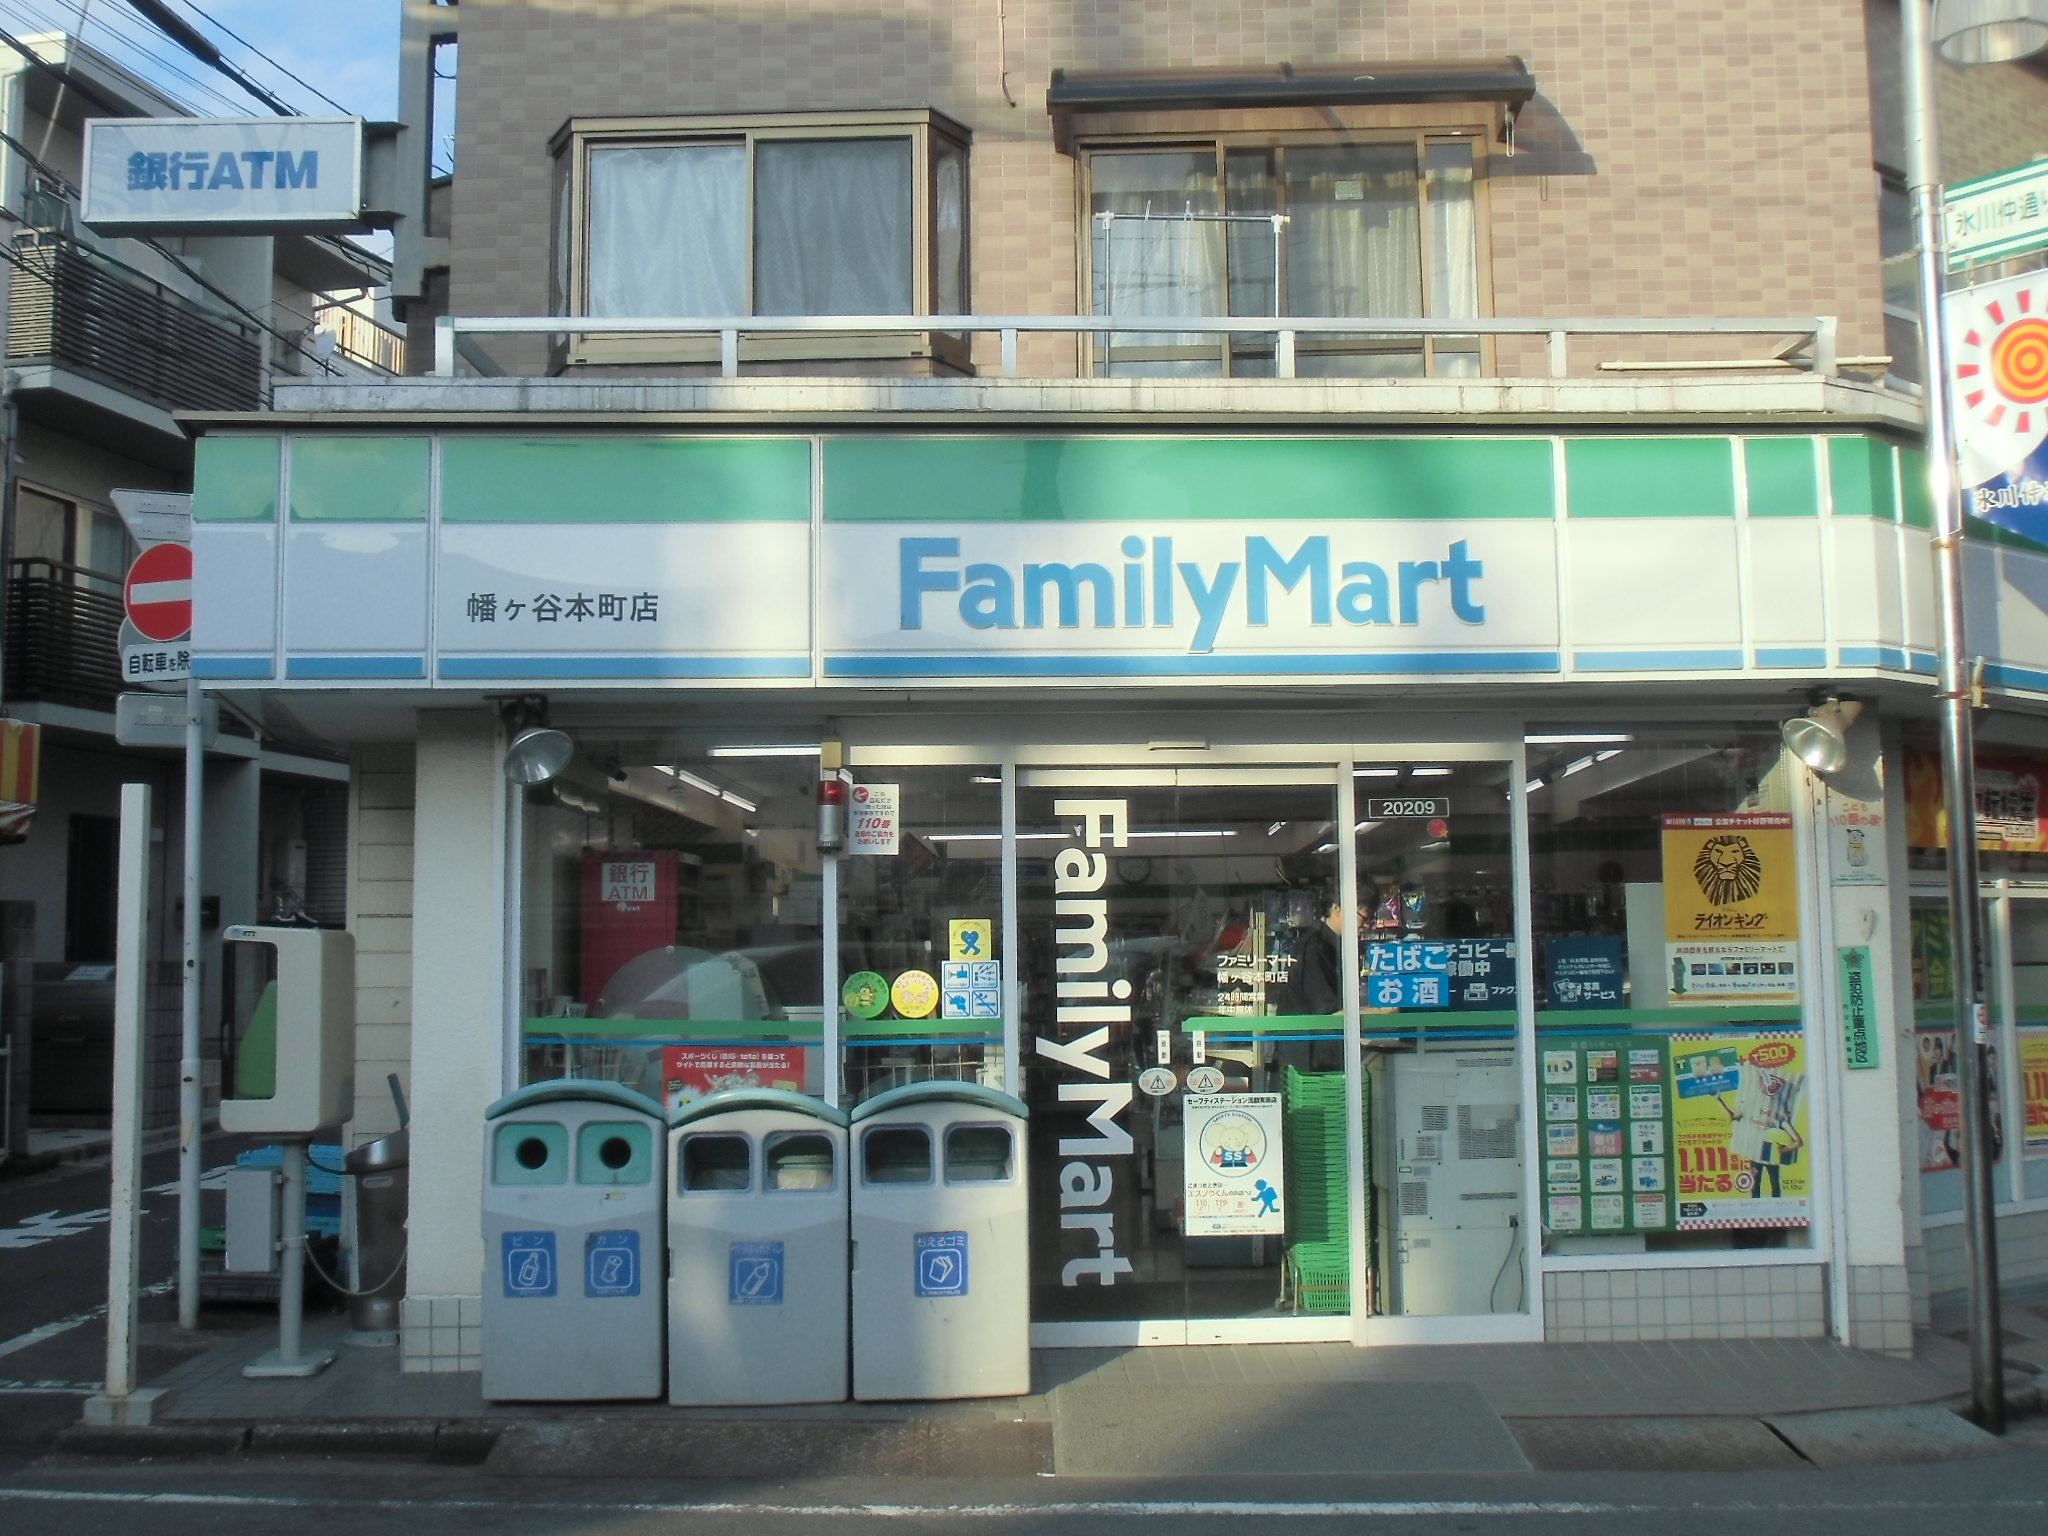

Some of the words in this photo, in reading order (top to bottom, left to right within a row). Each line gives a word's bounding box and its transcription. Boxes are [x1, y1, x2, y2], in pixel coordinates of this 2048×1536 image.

[127, 151, 318, 191] 銀行ATM
[1956, 190, 2048, 236] 氷川仲通
[899, 535, 1486, 654] FamilyMart
[467, 592, 659, 622] 幡ヶ谷本町店
[1383, 801, 1435, 815] 20209
[858, 818, 891, 828] 110番
[609, 864, 650, 883] 銀行
[608, 886, 648, 900] ATM
[1695, 913, 1764, 930] ライオンキング
[1217, 954, 1297, 967] ファミリーマート
[1370, 944, 1446, 972] たばこ
[1491, 986, 1517, 994] ファク
[1584, 991, 1616, 1000] サービス
[1036, 799, 1133, 1287] FamilyMart
[1224, 1151, 1243, 1161] SS
[1679, 1174, 1733, 1193] 当たる
[512, 1235, 544, 1246] ビン
[917, 1235, 965, 1248] もえるゴミ
